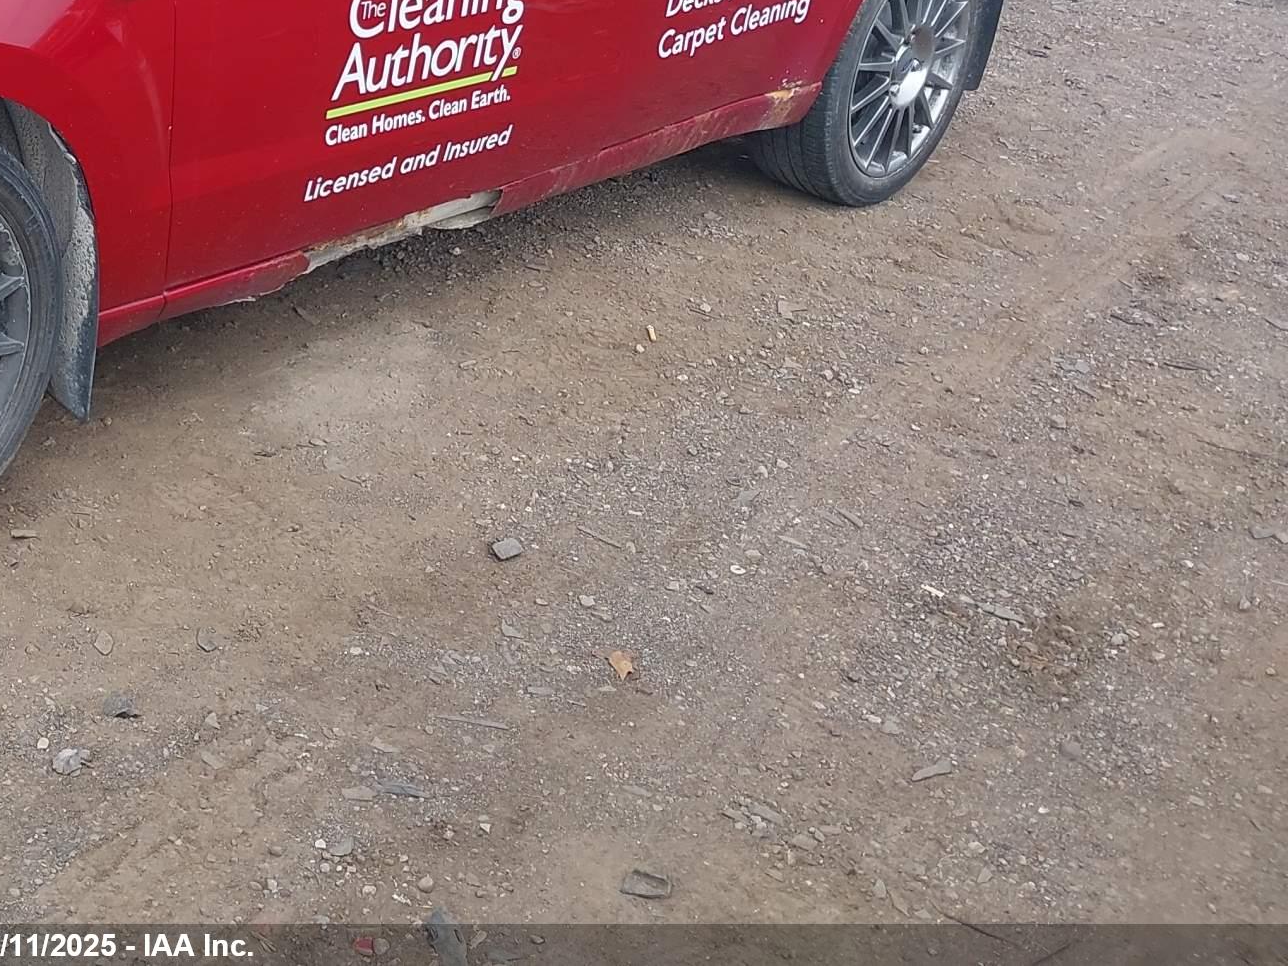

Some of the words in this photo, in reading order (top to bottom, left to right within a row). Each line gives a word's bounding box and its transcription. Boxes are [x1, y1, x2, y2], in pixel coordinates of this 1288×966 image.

[361, 0, 386, 20] The
[658, 16, 732, 58] Carpet
[325, 124, 368, 146] Clean
[372, 107, 426, 135] Homes.
[428, 99, 467, 121] Clean
[471, 84, 511, 110] Earth.
[304, 156, 397, 202] Licensed
[400, 143, 441, 175] and
[443, 124, 513, 162] Insured
